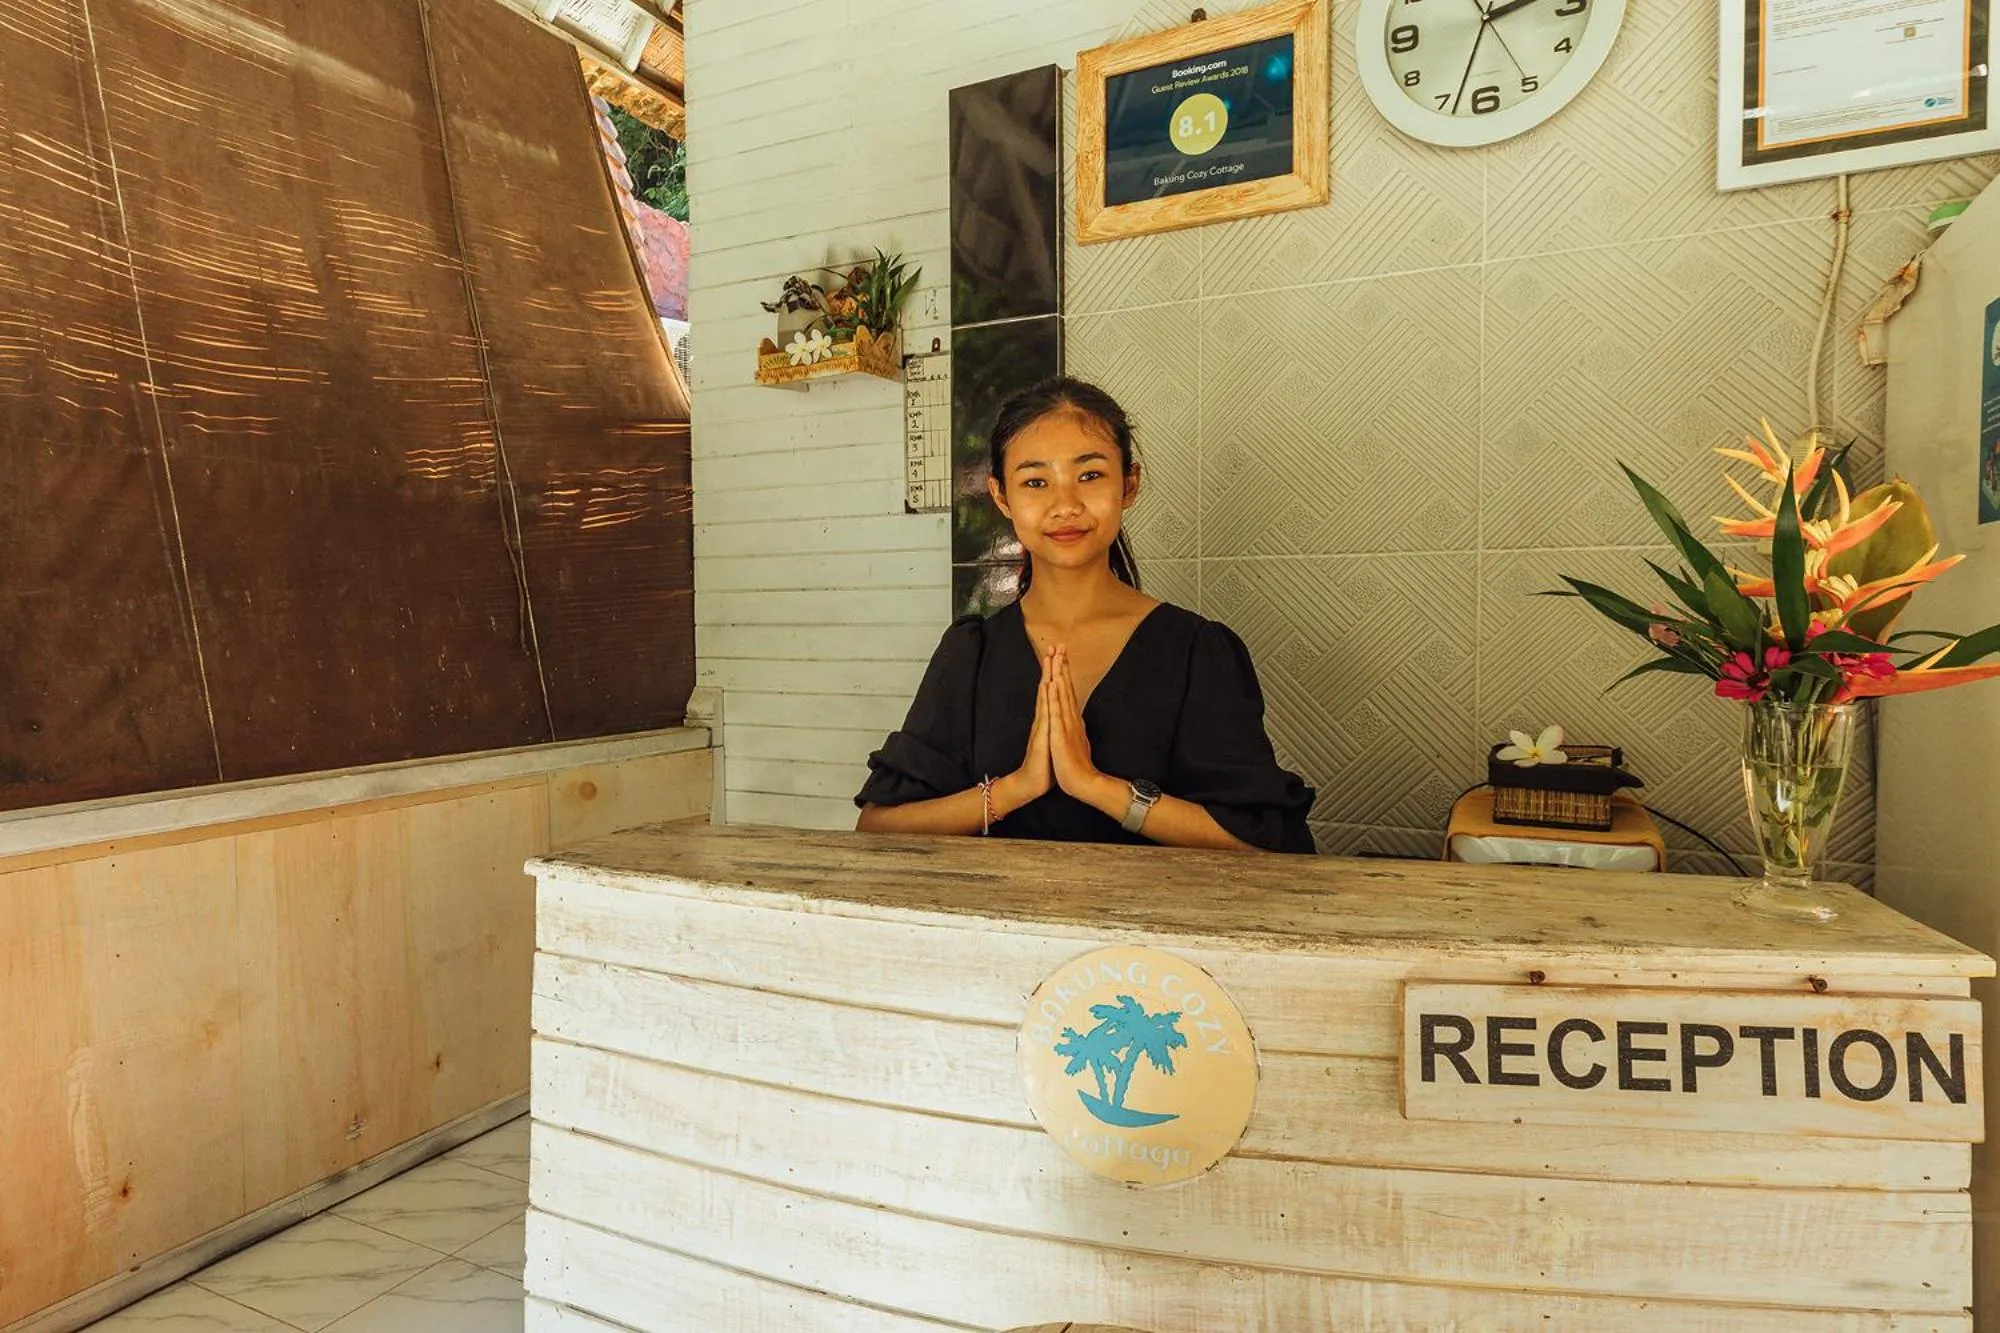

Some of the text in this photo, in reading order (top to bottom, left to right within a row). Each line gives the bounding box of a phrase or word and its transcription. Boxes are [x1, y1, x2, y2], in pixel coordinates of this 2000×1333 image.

[1391, 25, 1419, 54] 9
[1553, 37, 1573, 54] 4
[1171, 60, 1228, 79] Booking.com
[1404, 70, 1421, 87] 8
[1151, 83, 1174, 95] Guest
[1174, 78, 1201, 90] Review
[1201, 72, 1229, 83] Awards
[1520, 75, 1539, 93] 5
[1434, 93, 1451, 111] 7
[1471, 86, 1501, 115] 6
[1178, 110, 1217, 139] 8.1
[1153, 163, 1246, 187] Bakung Cozy Cottage
[1162, 973, 1231, 1056] COZY
[1420, 1013, 1967, 1105] RECEPTION
